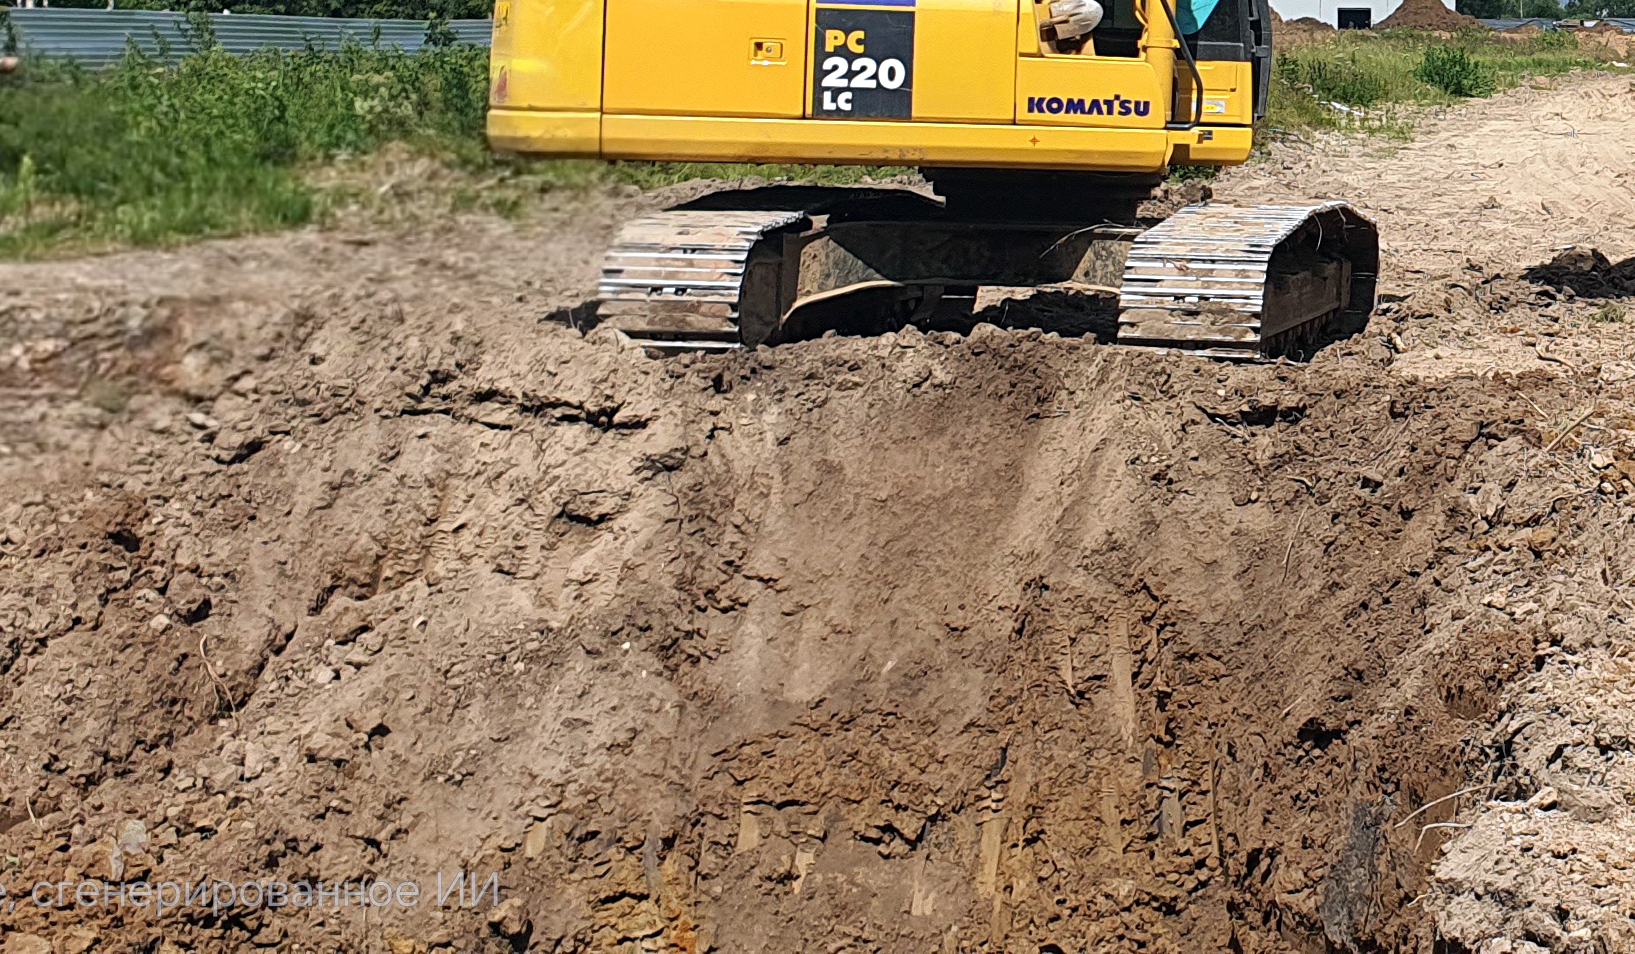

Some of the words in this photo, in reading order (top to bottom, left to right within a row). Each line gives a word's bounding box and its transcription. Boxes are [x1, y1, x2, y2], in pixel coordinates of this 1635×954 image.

[824, 29, 866, 54] PC
[821, 56, 906, 90] 220
[822, 90, 853, 111] LC
[1027, 94, 1151, 117] KOMATSU
